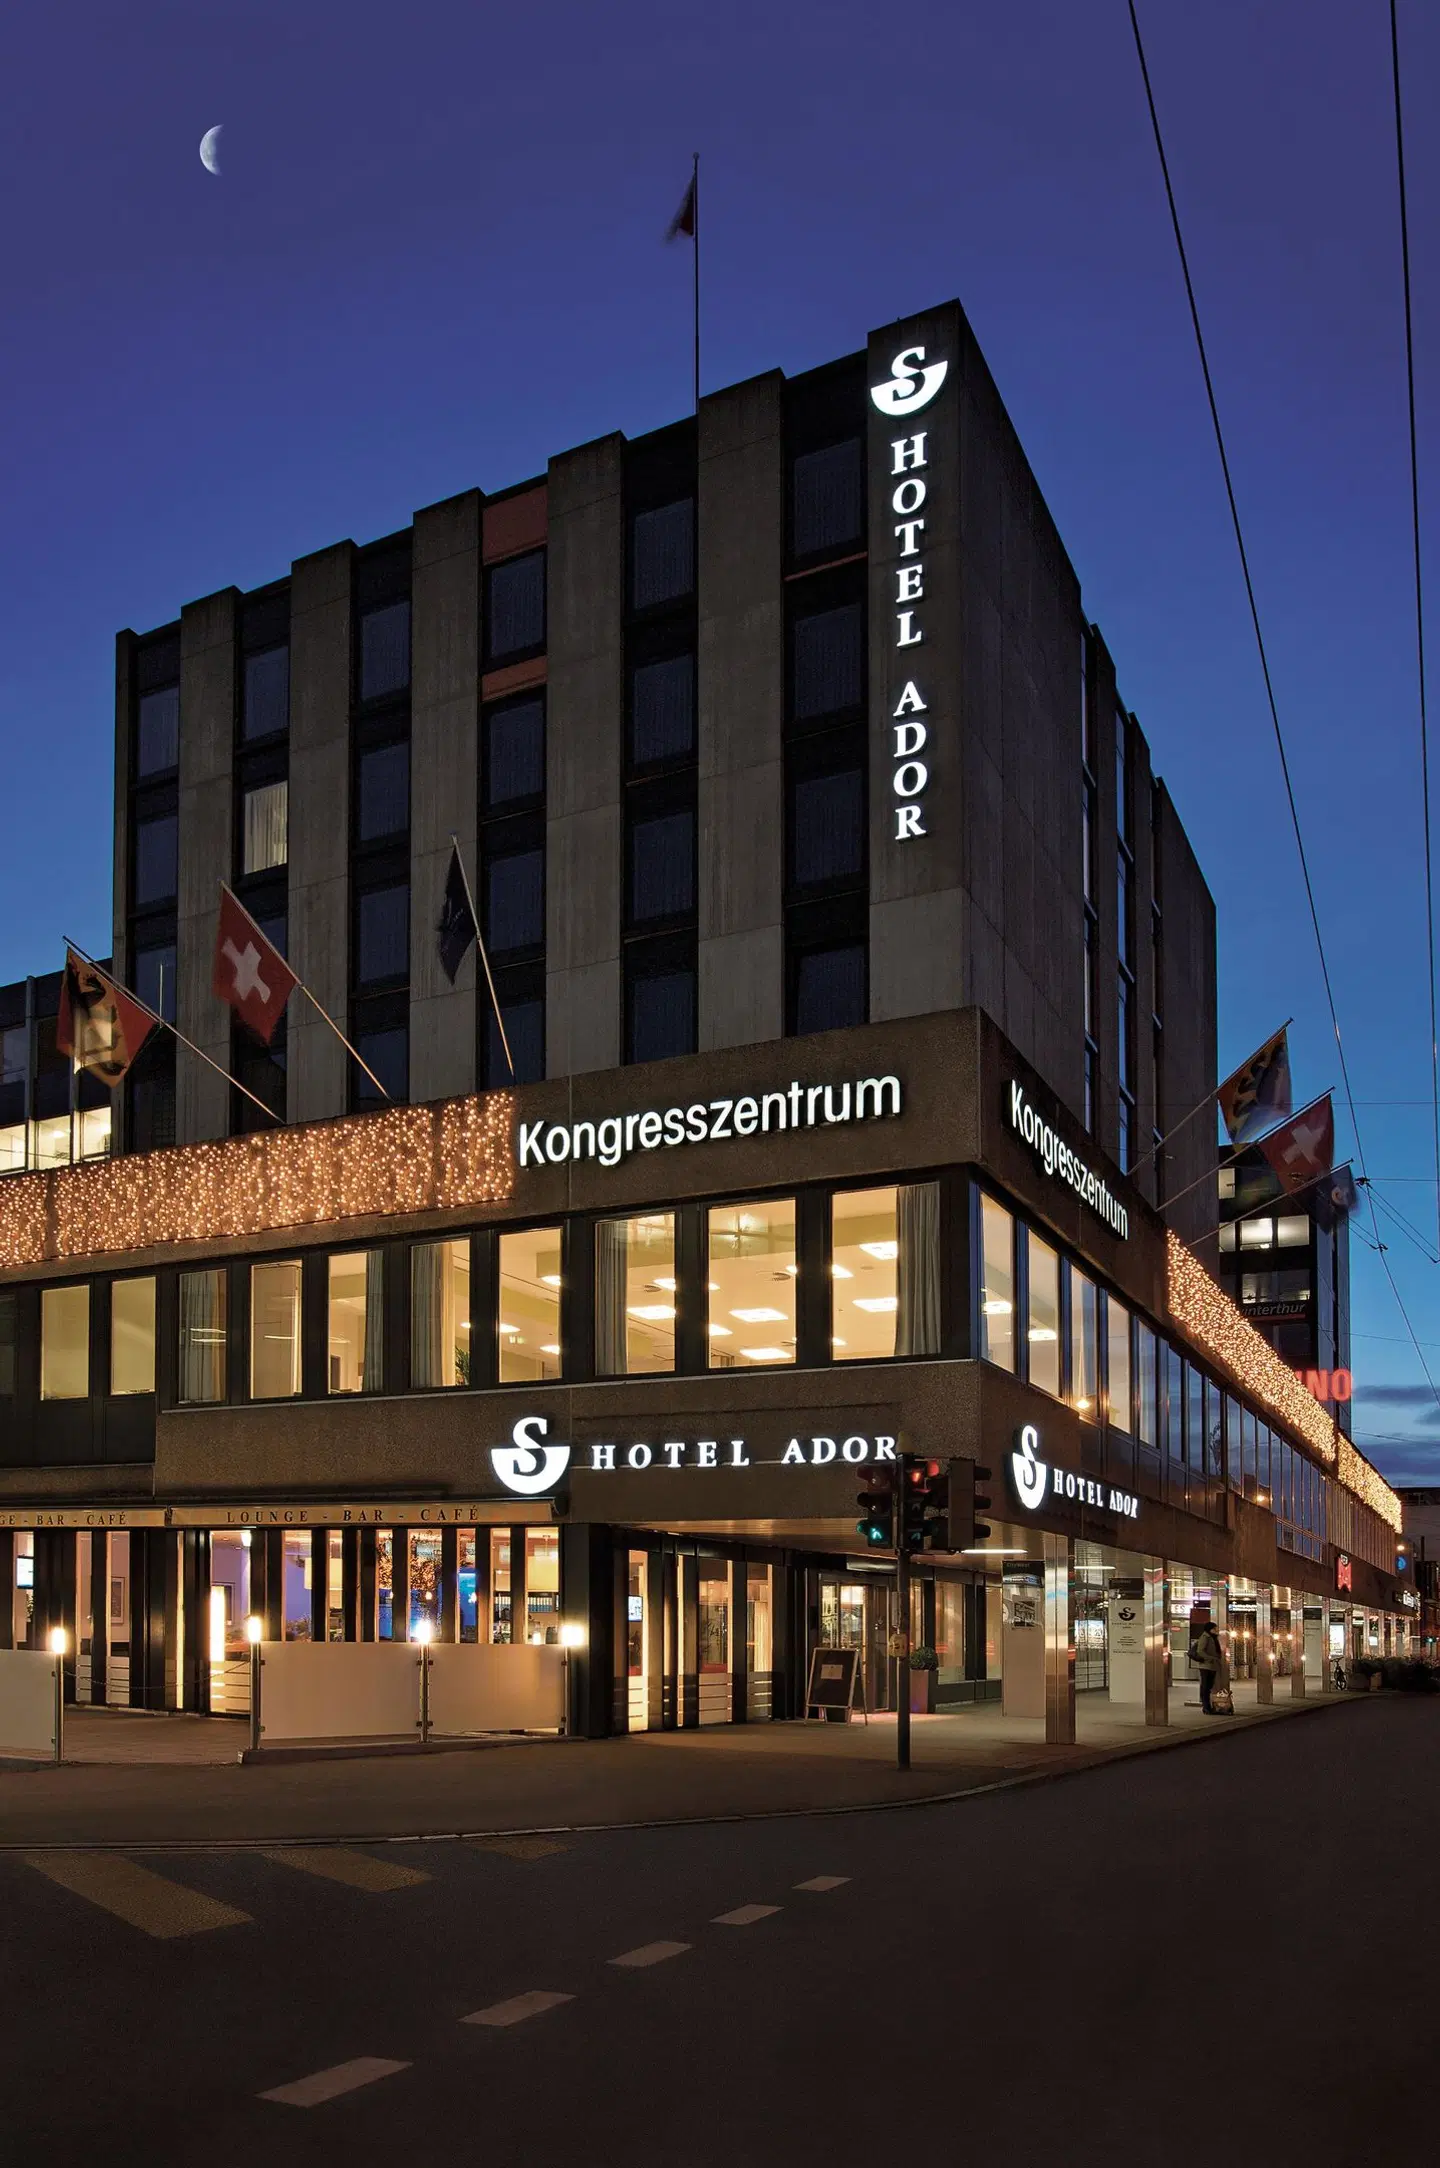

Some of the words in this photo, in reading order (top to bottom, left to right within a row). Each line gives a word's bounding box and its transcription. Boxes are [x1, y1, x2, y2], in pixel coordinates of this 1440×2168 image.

[891, 432, 927, 646] HOTEL
[893, 681, 927, 840] ADOR
[519, 1075, 901, 1167] Kongresszentrum
[1011, 1080, 1128, 1241] Kongresszentrum
[590, 1440, 749, 1470] HOTEL
[780, 1436, 896, 1465] ADOR
[37, 1514, 65, 1525] BAR
[87, 1511, 127, 1525] CAFÉ
[227, 1511, 308, 1523] LOUNGE
[343, 1509, 384, 1522] BAR
[420, 1505, 479, 1521] CAFÉ
[1053, 1468, 1103, 1507] HOTEL
[1109, 1489, 1138, 1519] ADOR
